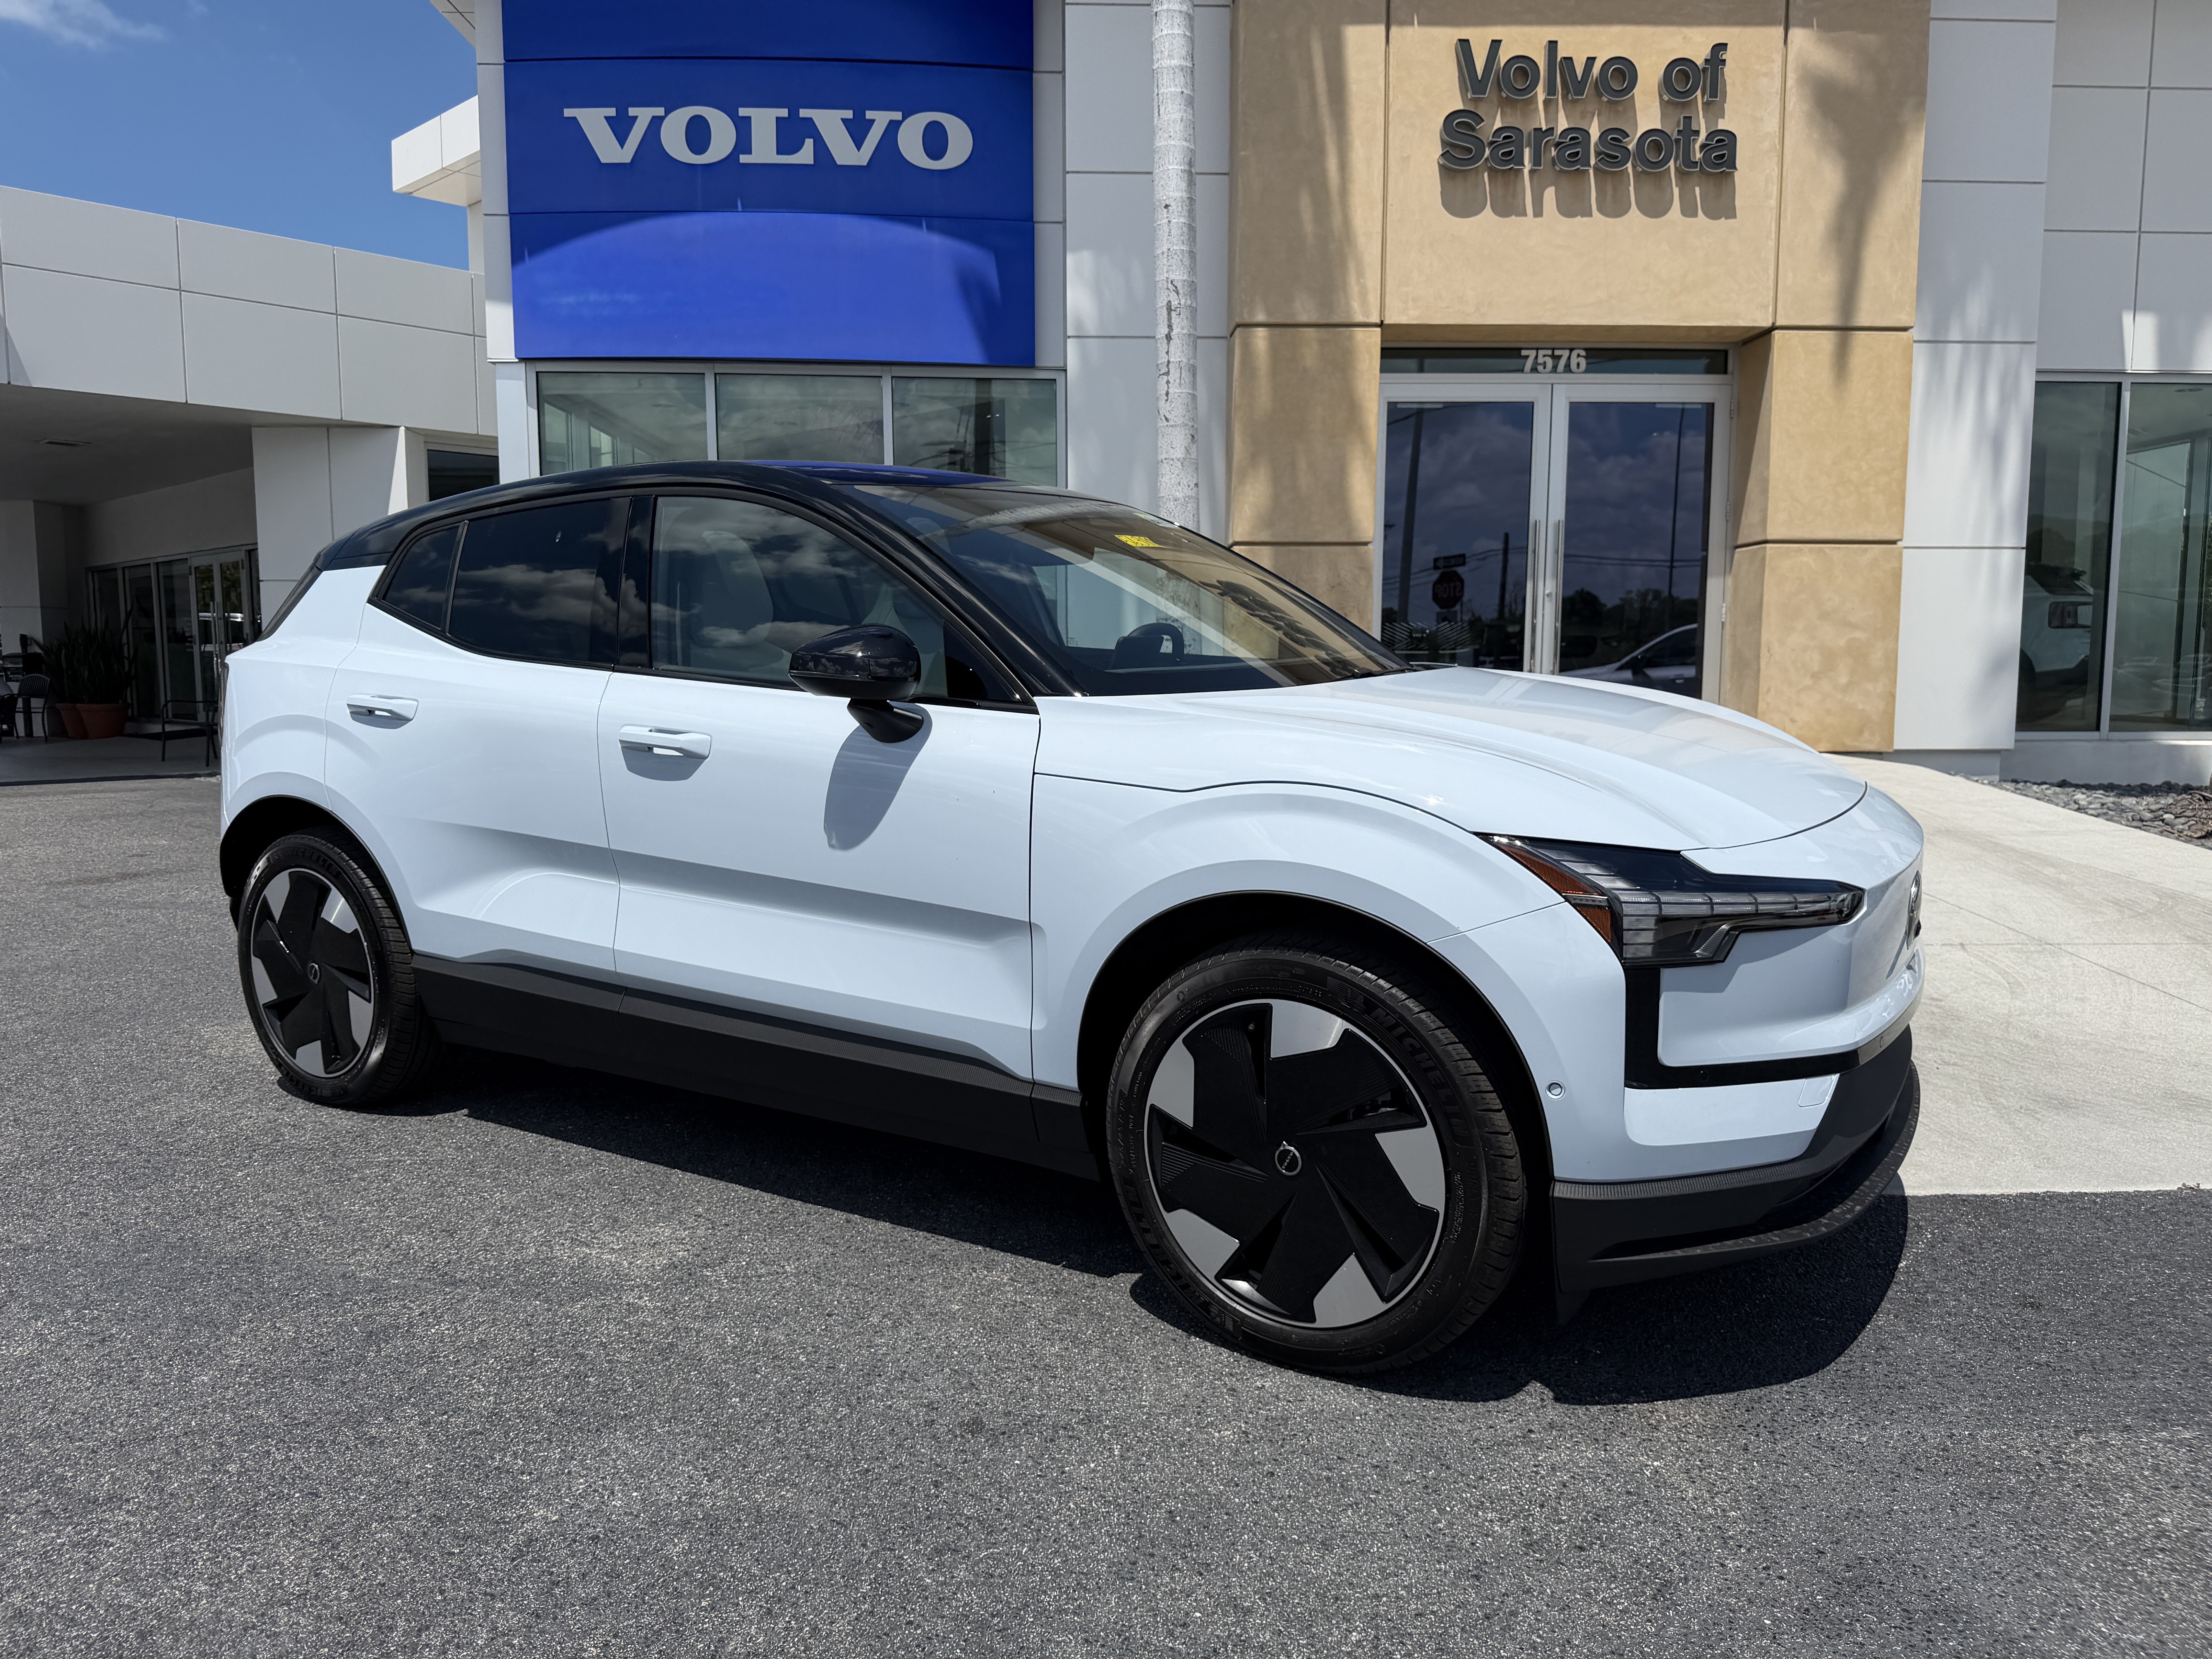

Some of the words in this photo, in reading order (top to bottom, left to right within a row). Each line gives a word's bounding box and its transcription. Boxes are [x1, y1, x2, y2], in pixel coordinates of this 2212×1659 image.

[1455, 39, 1638, 100] Volvo
[1659, 43, 1728, 101] of
[564, 106, 974, 170] VOLVO
[1437, 109, 1738, 172] Sarasota
[1520, 349, 1587, 374] 7576
[1369, 1004, 1470, 1138] MICHELIN
[1282, 1152, 1293, 1168] VOLVO
[1125, 1184, 1204, 1307] MICHELIN
